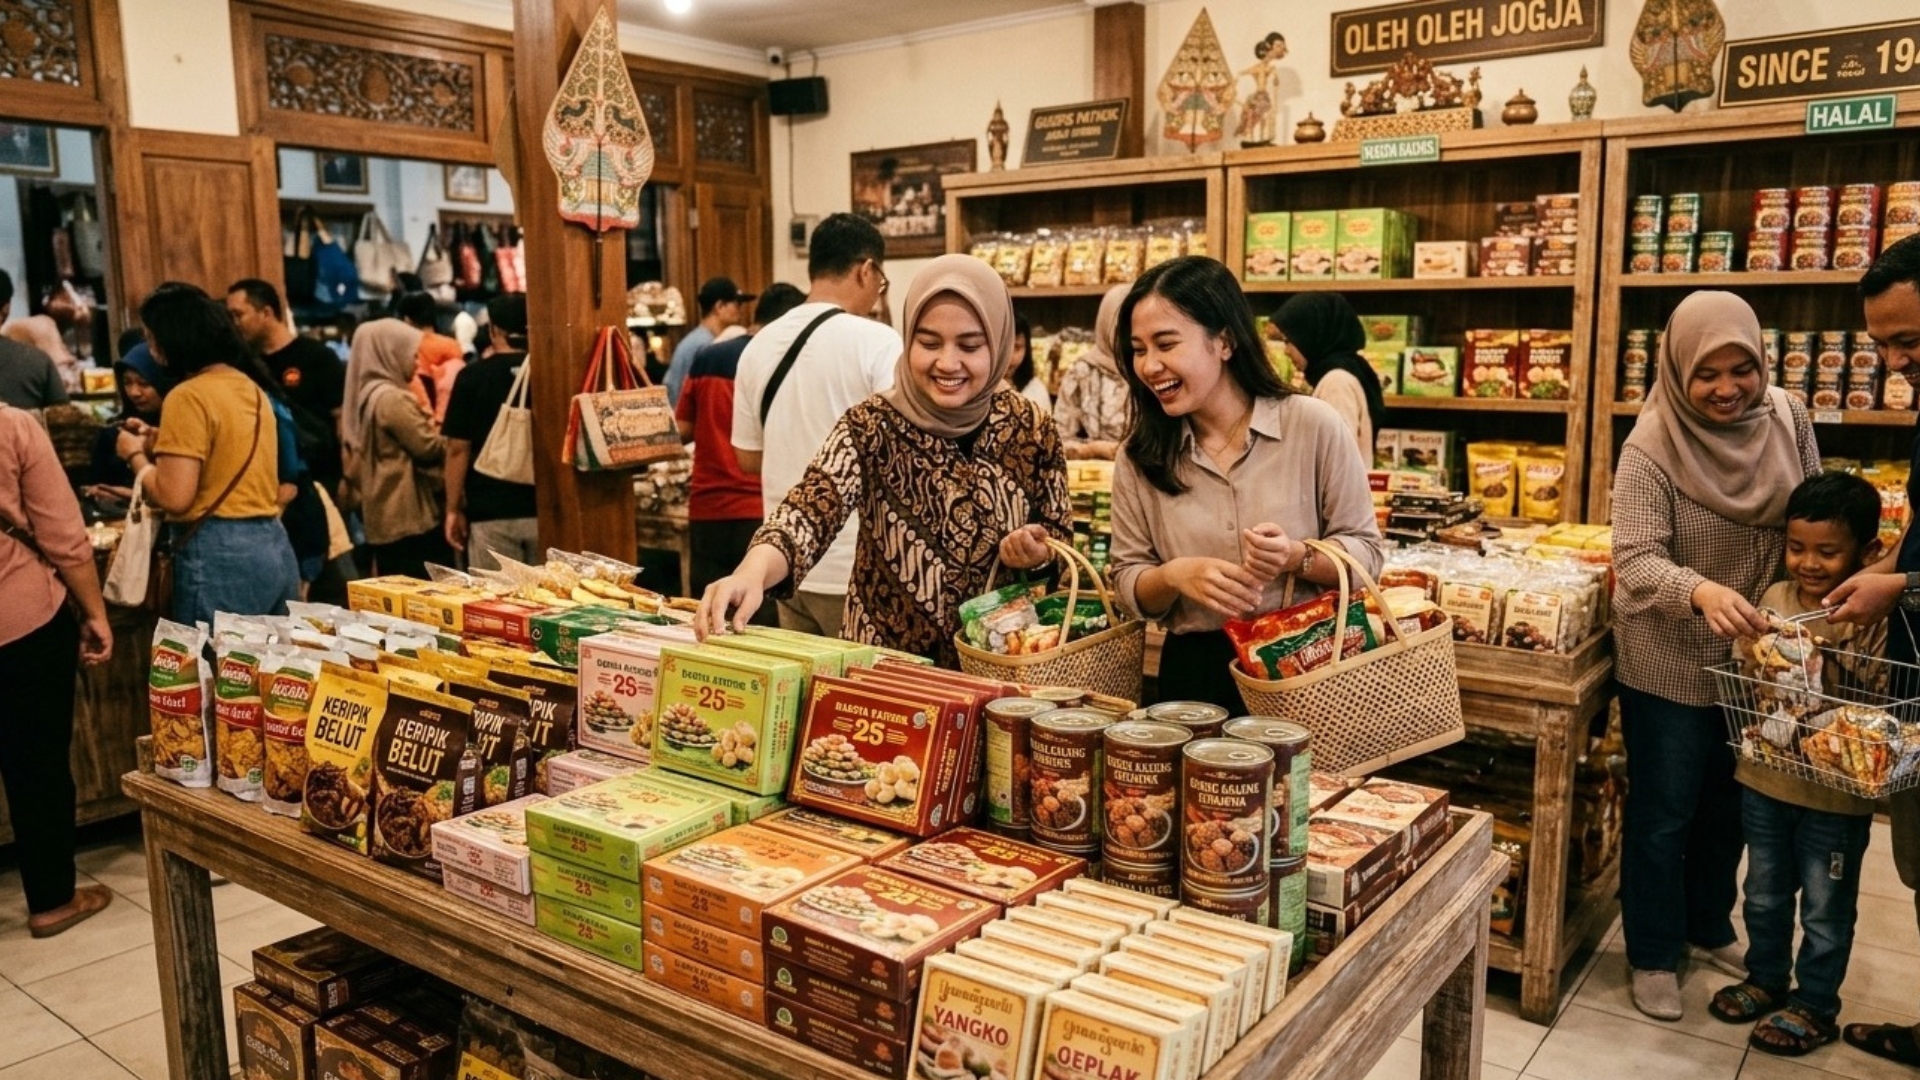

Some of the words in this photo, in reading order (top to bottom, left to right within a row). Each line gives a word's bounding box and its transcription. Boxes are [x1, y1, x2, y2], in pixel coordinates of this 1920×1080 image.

[1344, 18, 1409, 55] OLEH
[1416, 7, 1484, 46] OLEH
[1491, 0, 1583, 37] JOGJA
[1737, 46, 1830, 89] SINCE
[1812, 101, 1887, 128] HALAL
[322, 695, 372, 725] KERIPIK
[698, 685, 726, 711] 25
[314, 715, 366, 751] BELUT
[852, 718, 886, 746] 25
[388, 737, 445, 776] BELUT
[933, 1004, 1009, 1047] YANGKO
